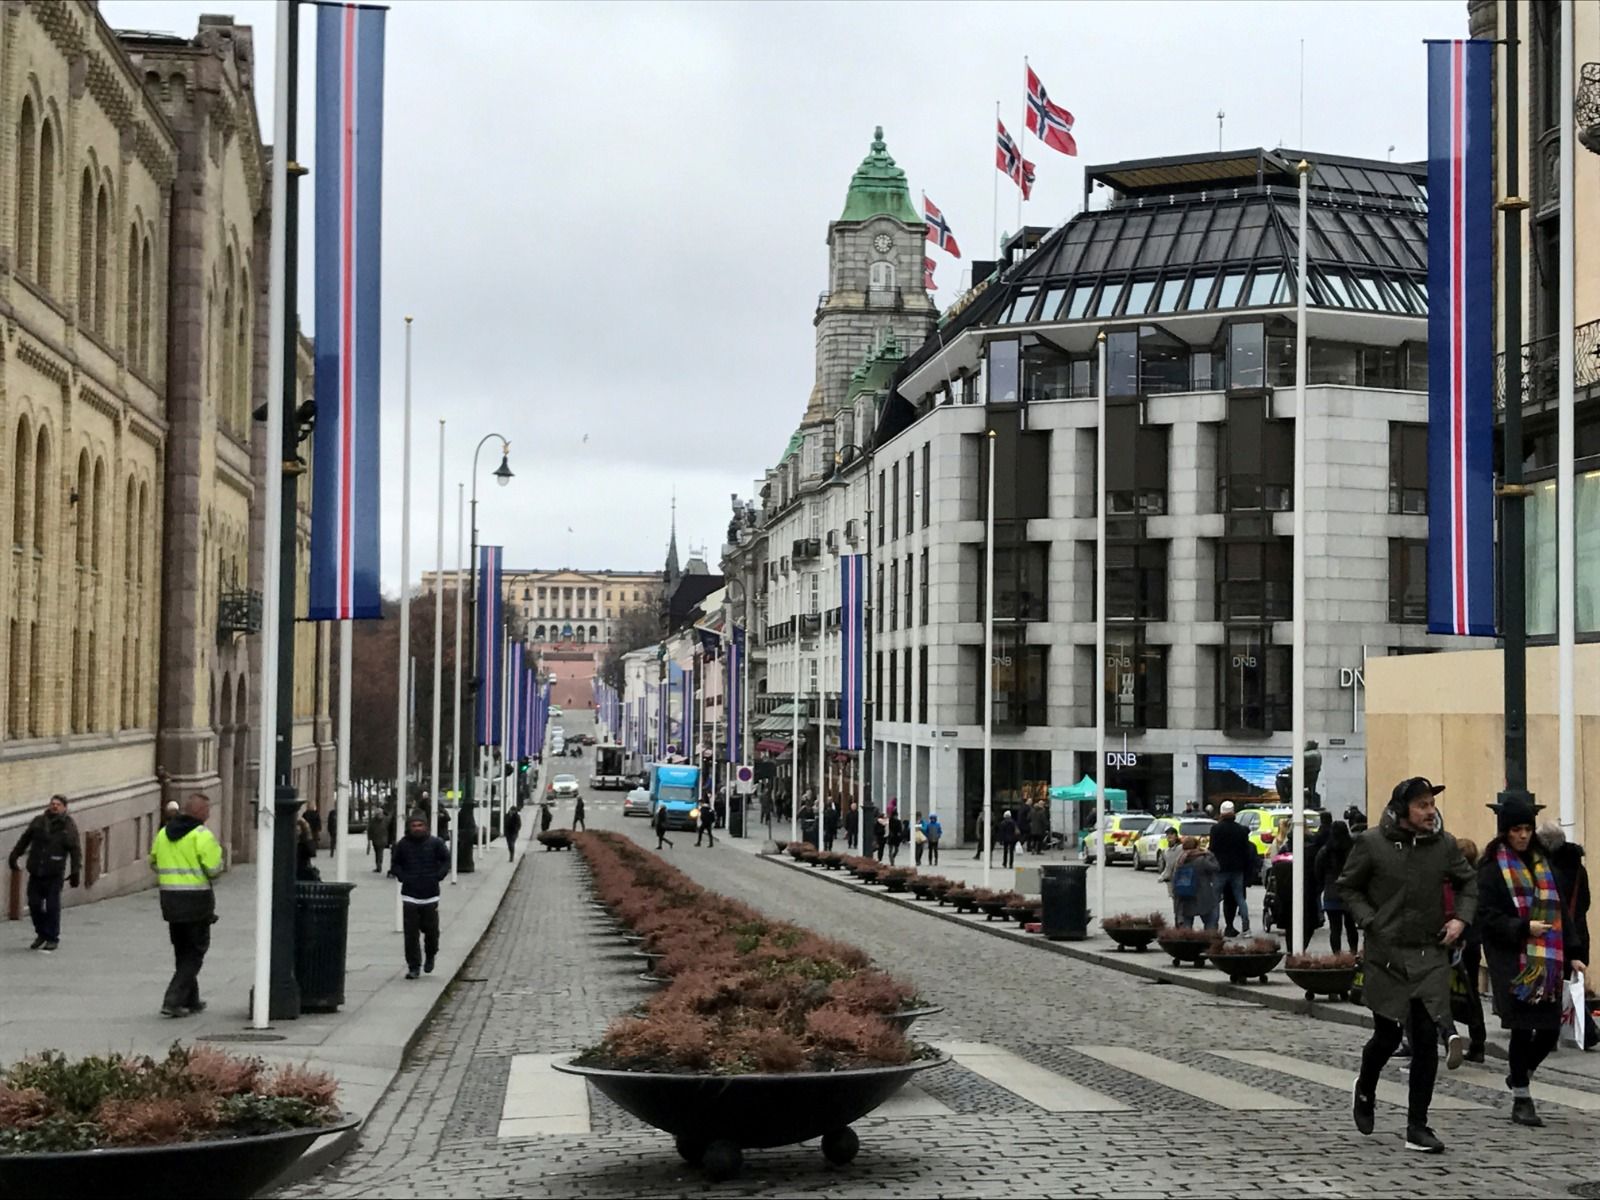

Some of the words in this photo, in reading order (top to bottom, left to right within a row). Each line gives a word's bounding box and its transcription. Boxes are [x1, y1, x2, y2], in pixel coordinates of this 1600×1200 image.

[1107, 656, 1131, 668] DNB
[1232, 656, 1257, 668] DNB
[1106, 752, 1137, 769] DNB
